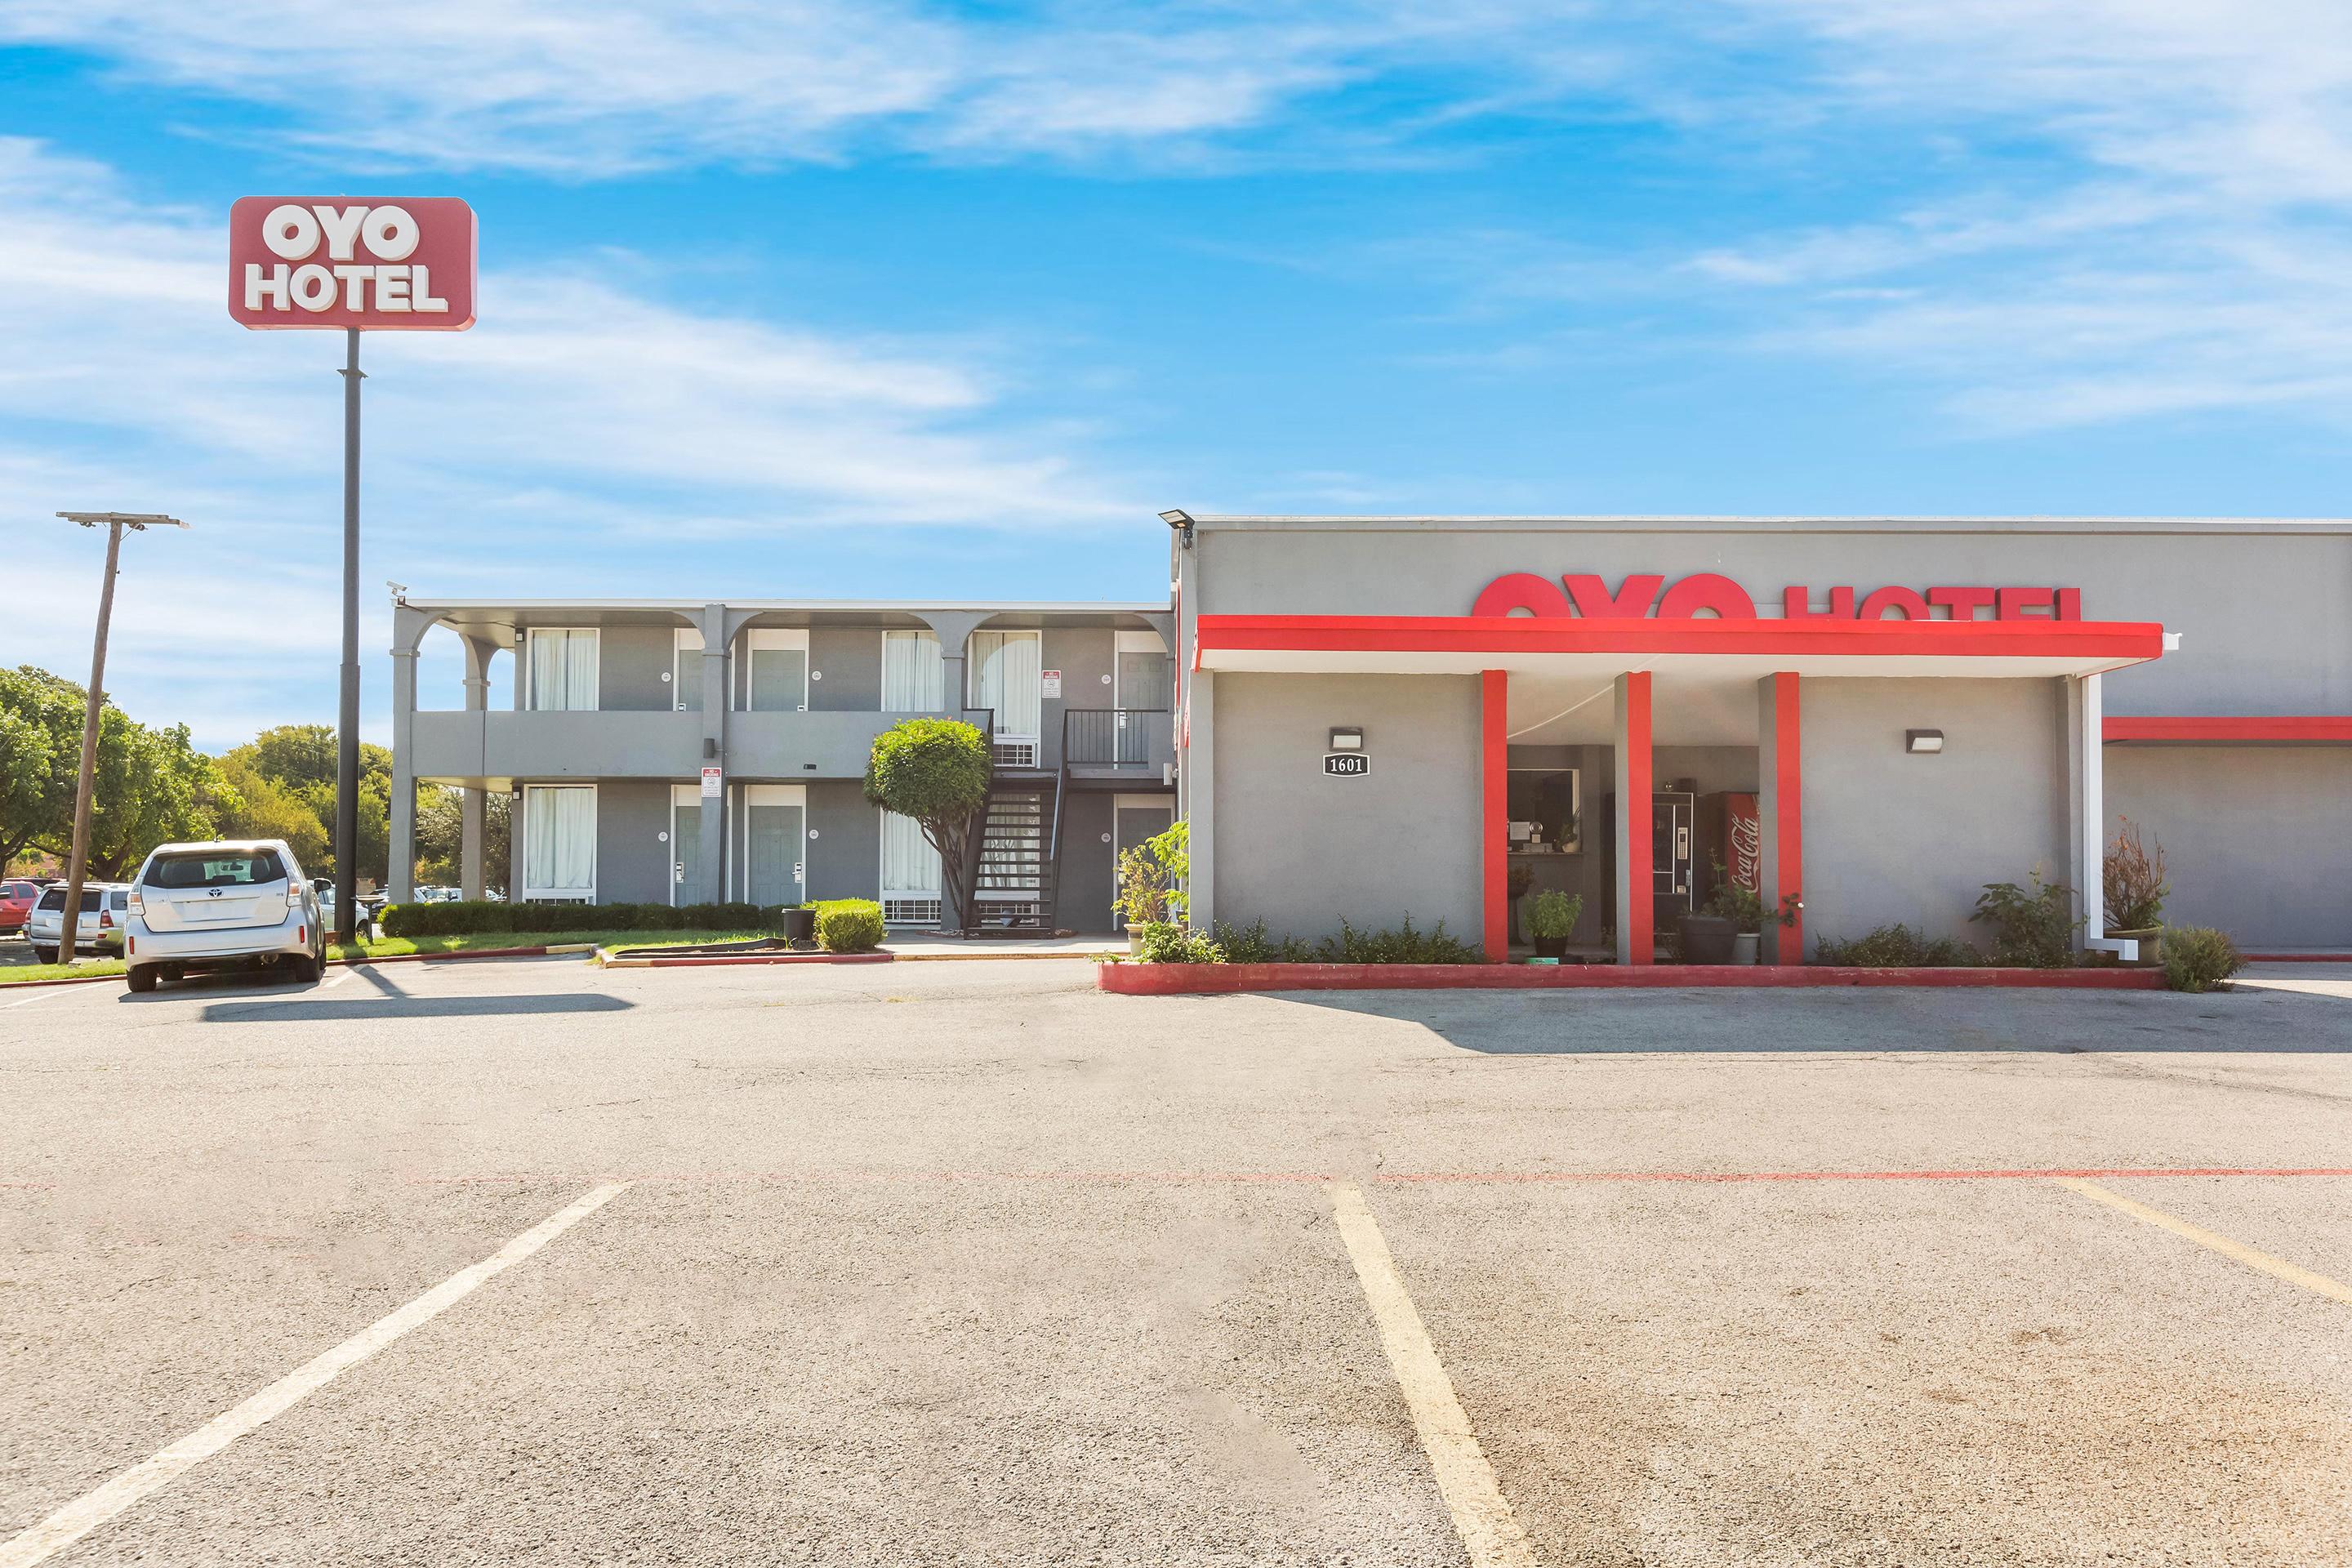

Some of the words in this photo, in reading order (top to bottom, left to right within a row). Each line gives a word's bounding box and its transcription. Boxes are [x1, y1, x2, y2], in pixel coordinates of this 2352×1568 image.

[262, 204, 420, 261] OYO
[245, 263, 448, 312] HOTEL
[1330, 758, 1362, 772] 1601
